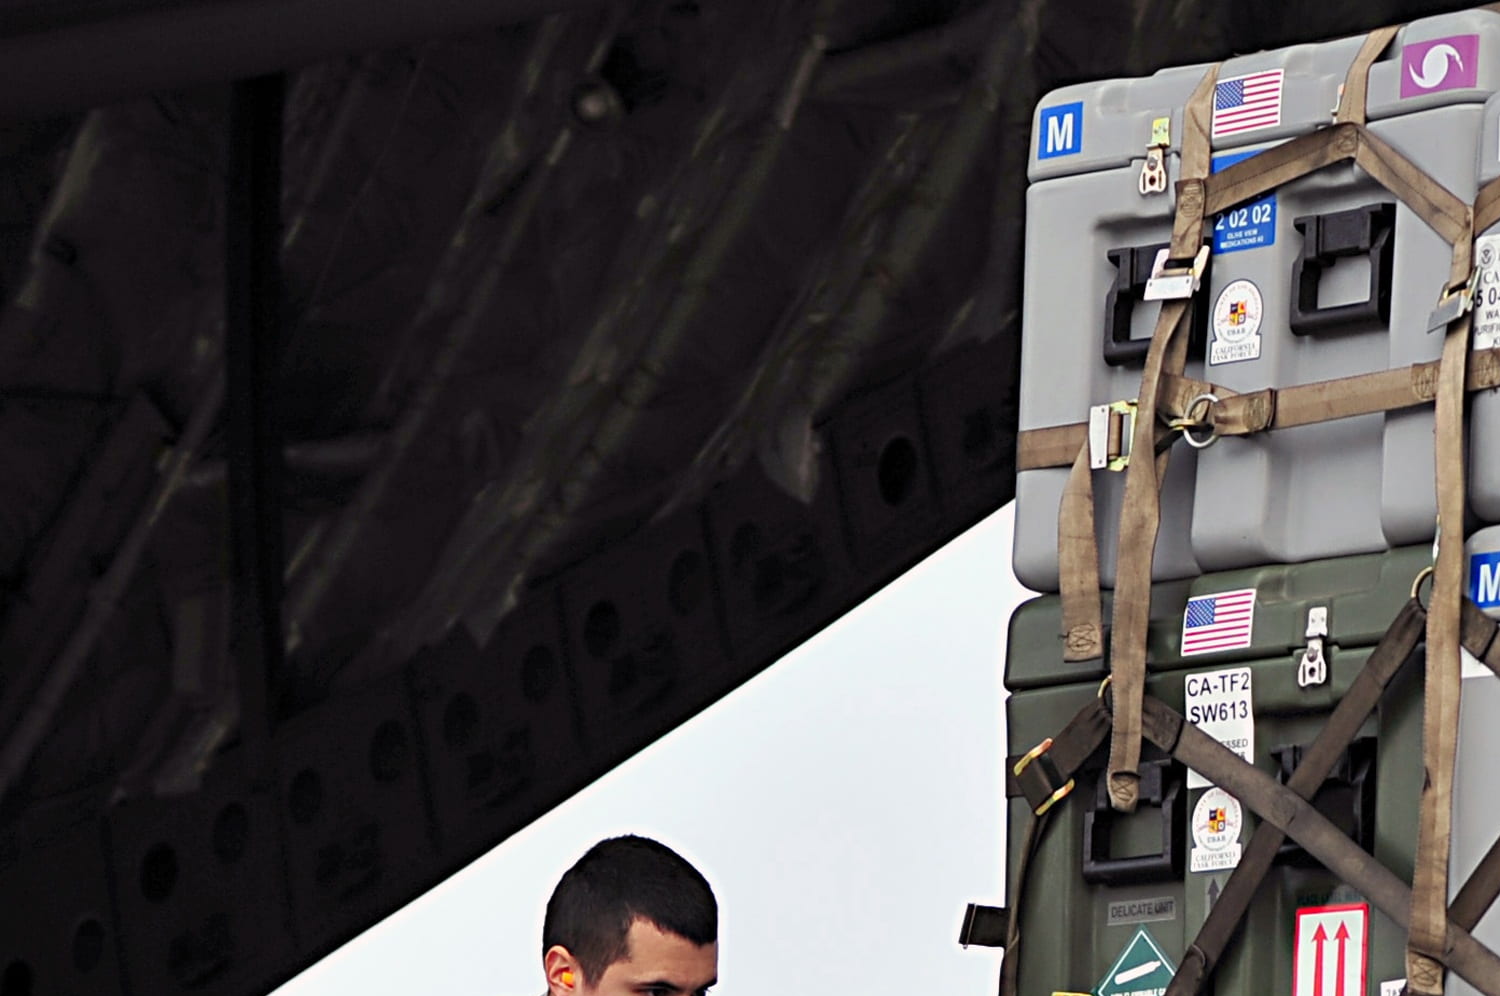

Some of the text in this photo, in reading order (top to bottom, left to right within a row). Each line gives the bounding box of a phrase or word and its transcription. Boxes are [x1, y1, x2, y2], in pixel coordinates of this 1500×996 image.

[1046, 113, 1074, 153] M
[1215, 203, 1272, 231] 2 02 02
[1187, 672, 1250, 698] CA-TF2
[1190, 700, 1248, 725] SW613
[1111, 901, 1173, 919] DELICATE UNIT
